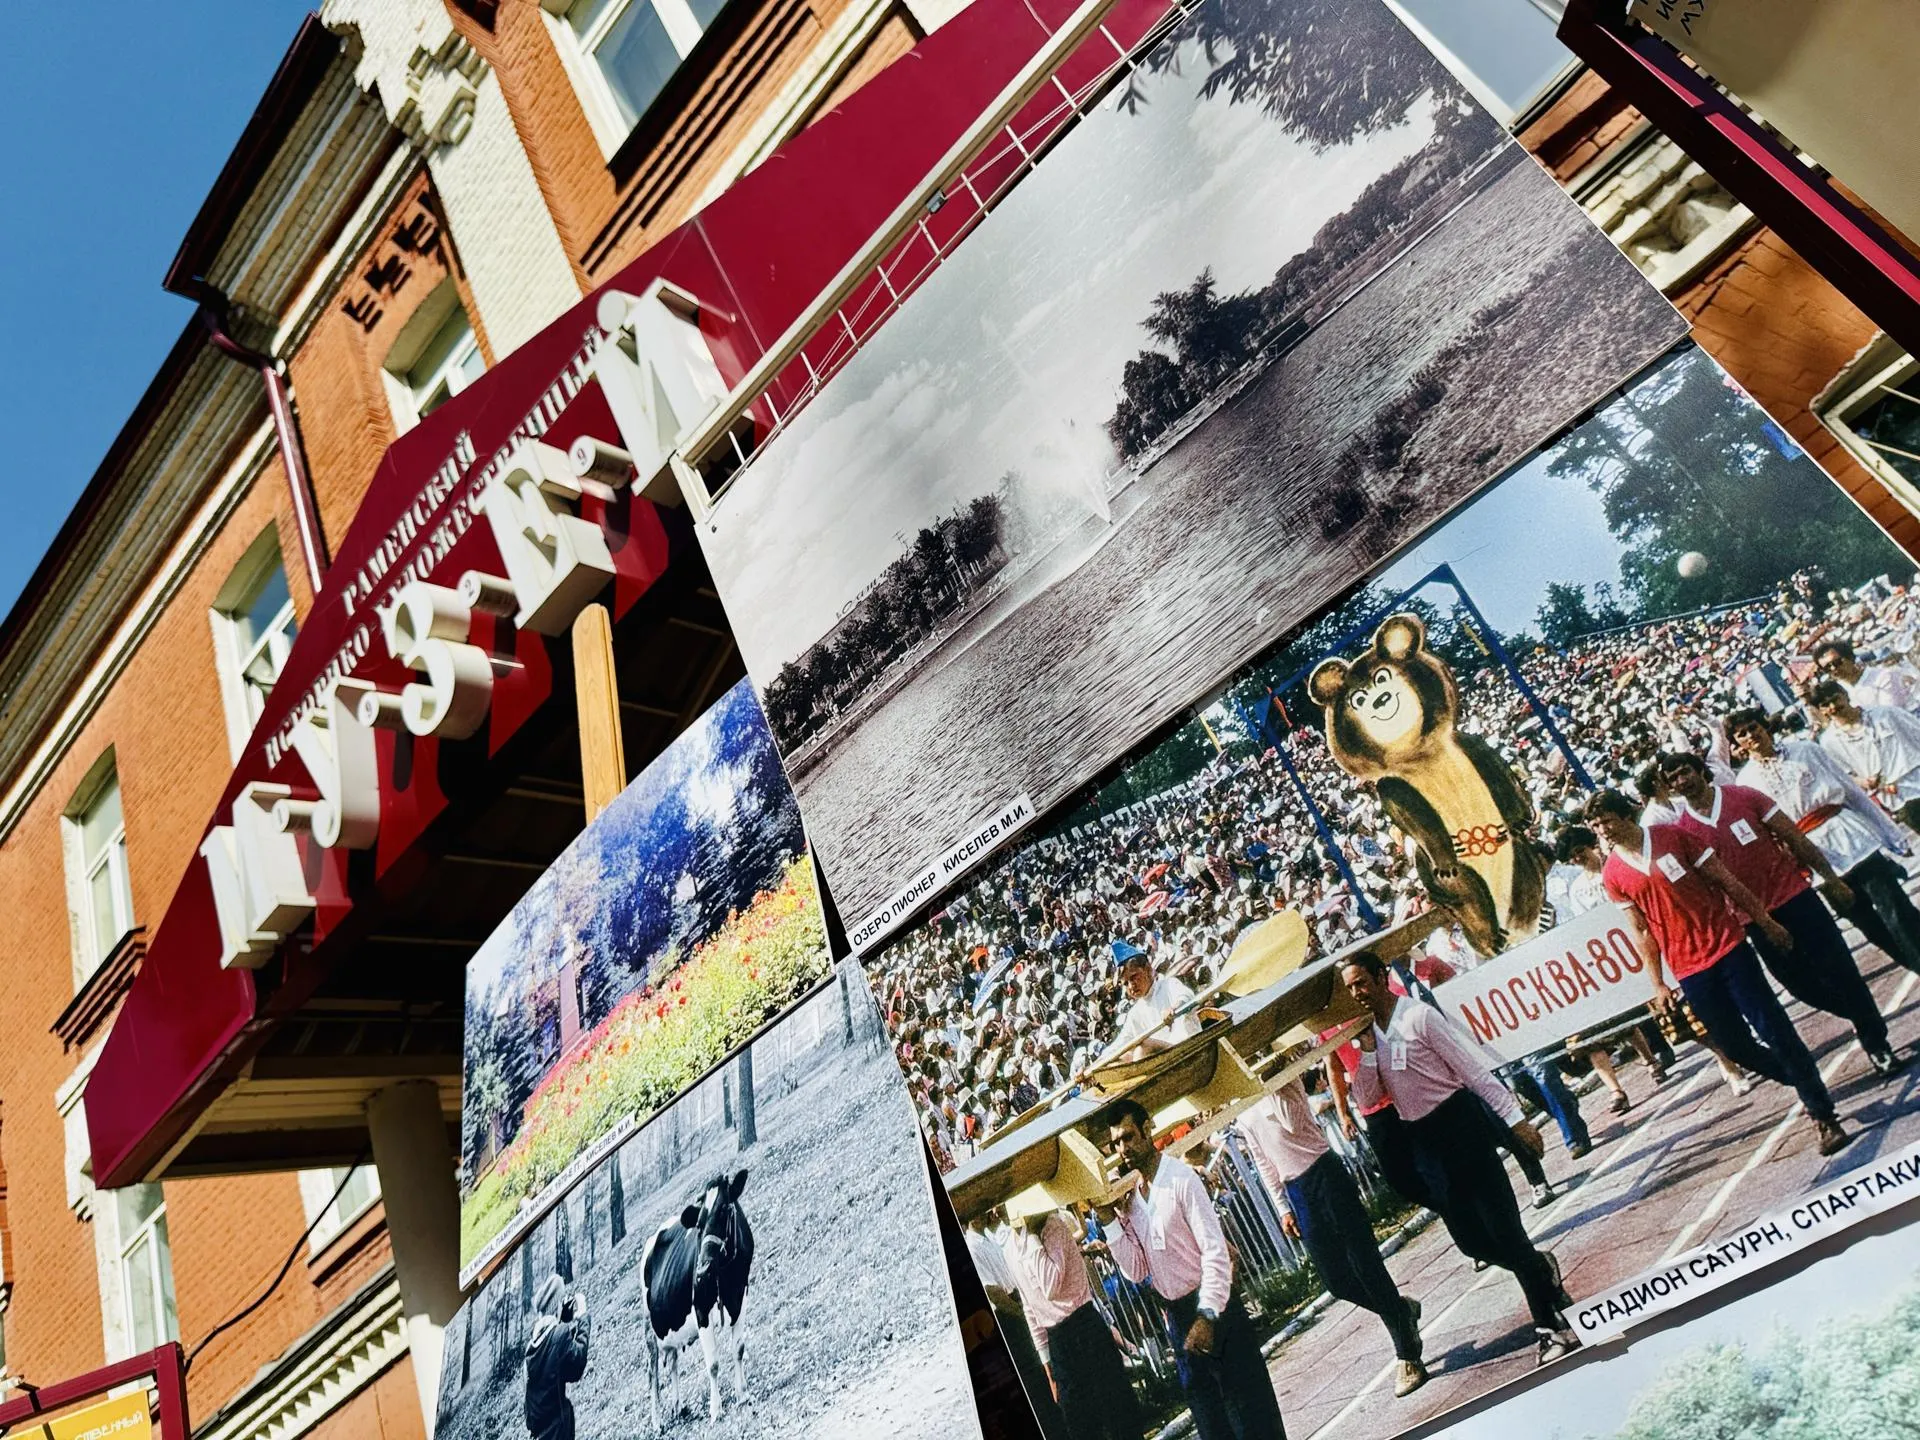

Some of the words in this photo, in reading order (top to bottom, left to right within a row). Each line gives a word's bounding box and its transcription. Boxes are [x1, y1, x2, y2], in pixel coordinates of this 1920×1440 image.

[341, 427, 477, 617] РАМЕНСКИЙ
[199, 275, 730, 970] МУЗЕЙ
[853, 911, 891, 946] ОЗЕРО
[893, 872, 937, 917] ПИОНЕР
[942, 825, 1000, 874] КИСЕЛЕВ
[1000, 804, 1029, 831] М.И.
[1459, 926, 1645, 1046] МОСКВА-80
[1578, 1268, 1690, 1331] СТАДИОН
[1688, 1222, 1793, 1279] САТУРН,
[1792, 1153, 1920, 1230] СПАРТАКИ
